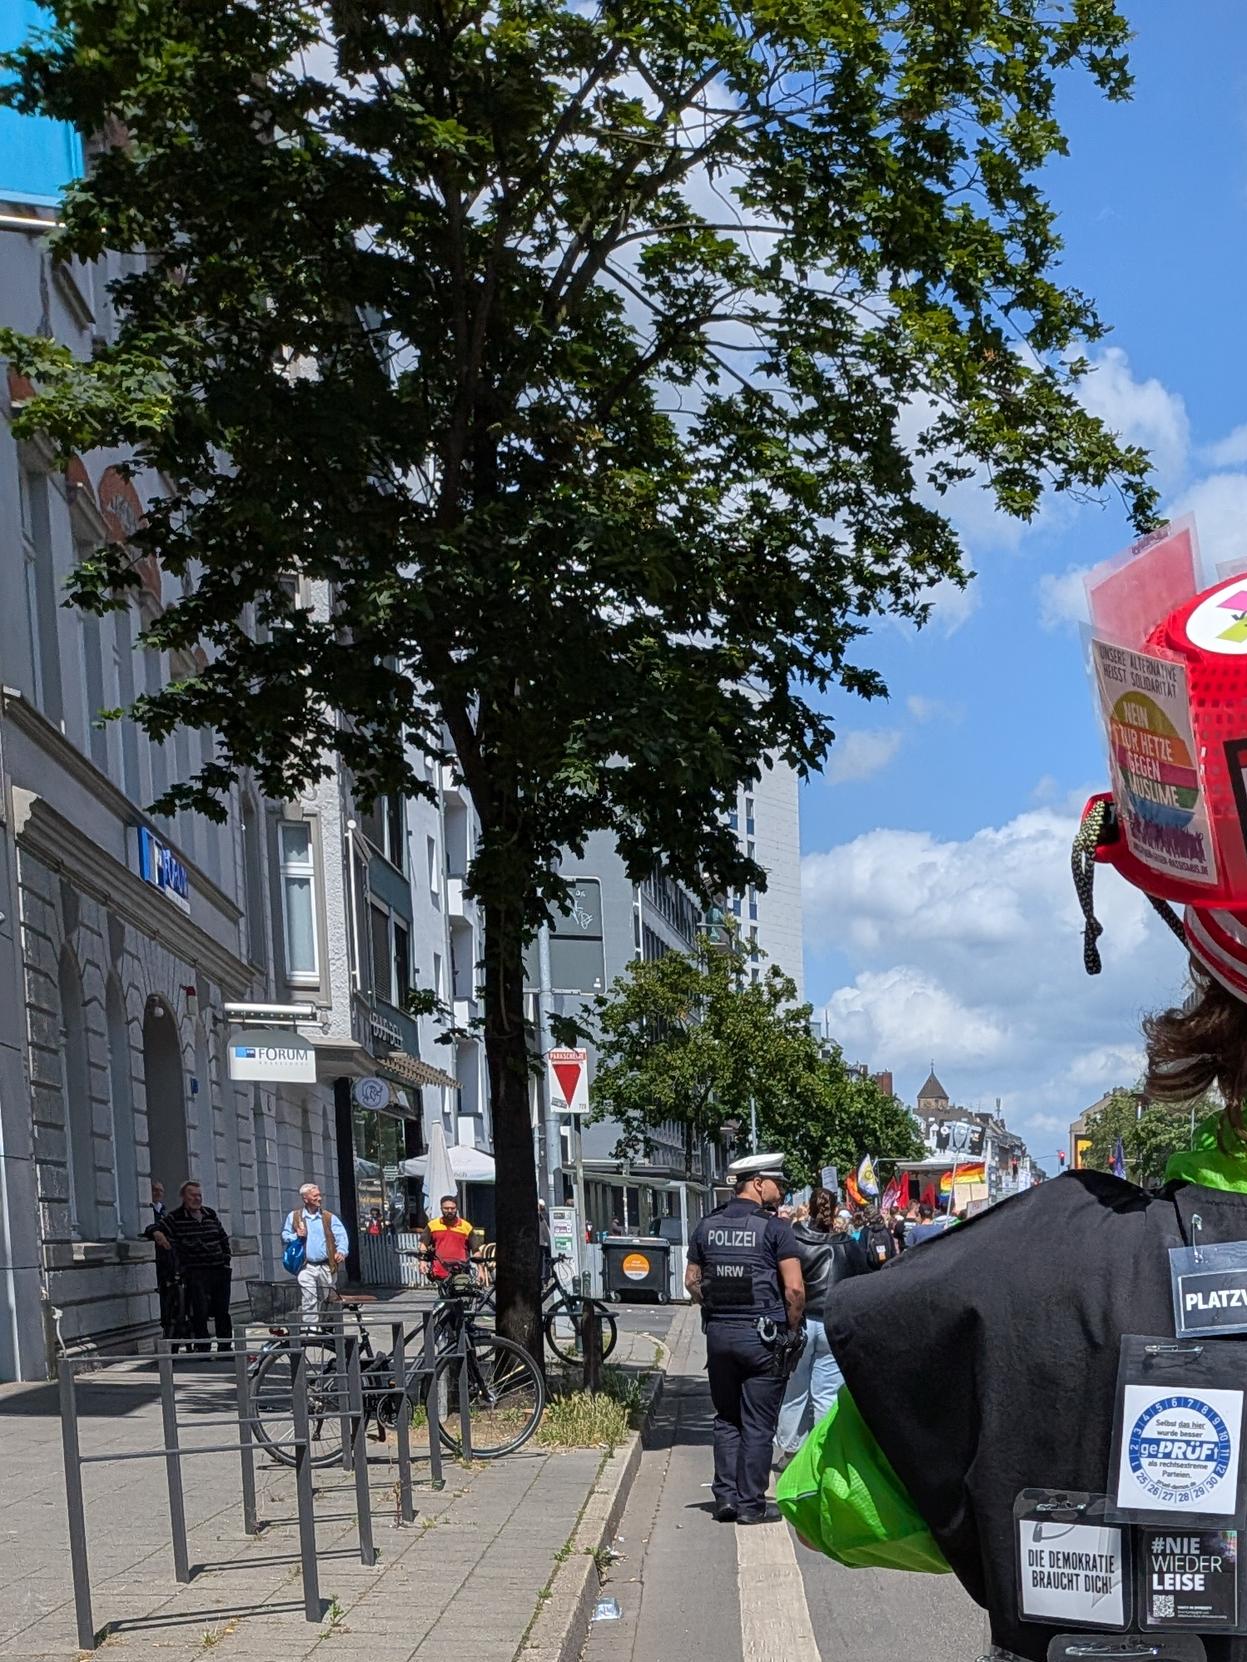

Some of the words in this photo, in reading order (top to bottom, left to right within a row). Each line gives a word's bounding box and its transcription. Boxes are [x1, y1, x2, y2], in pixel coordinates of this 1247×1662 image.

[1123, 701, 1148, 727] NEIN
[1128, 754, 1161, 781] GEGEN
[1129, 775, 1180, 806] MUSLIME
[258, 1048, 307, 1061] FORUM
[708, 1230, 755, 1247] POLIZEI
[716, 1265, 744, 1277] NRW
[1157, 1429, 1178, 1437] wurde
[1152, 1538, 1200, 1554] #NIE
[1028, 1550, 1044, 1566] DIE
[1050, 1551, 1115, 1573] DEMOKRATIE
[1152, 1556, 1221, 1573] WIEDER
[1032, 1571, 1080, 1590] BRAUCHT
[1084, 1576, 1112, 1594] DICH!
[1153, 1574, 1205, 1591] LEISE
